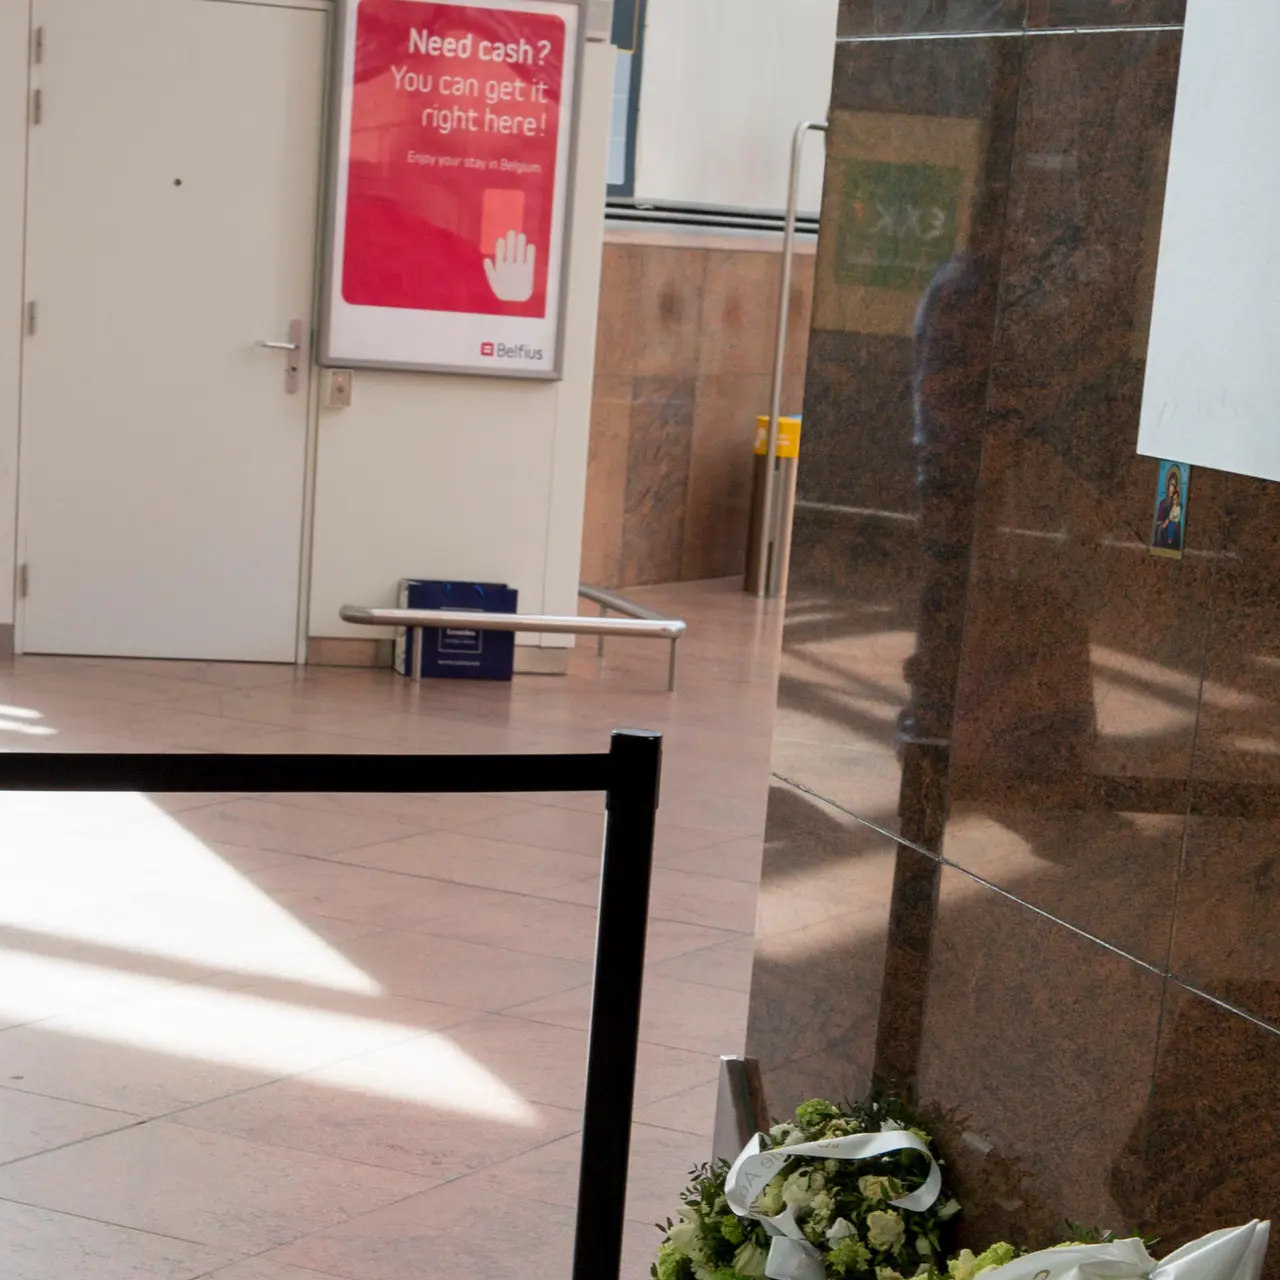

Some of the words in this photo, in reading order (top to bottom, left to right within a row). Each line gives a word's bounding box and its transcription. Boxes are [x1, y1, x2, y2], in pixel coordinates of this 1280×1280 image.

[409, 27, 472, 59] Need
[390, 65, 433, 93] You
[439, 76, 479, 97] can
[485, 79, 525, 104] get
[531, 79, 549, 104] it
[421, 104, 478, 135] right
[484, 108, 547, 137] here!
[407, 150, 436, 167] Enjoy
[438, 155, 462, 169] your
[464, 156, 487, 173] stay
[489, 159, 499, 170] in
[500, 158, 542, 175] Belgium
[496, 343, 544, 361] Belfius
